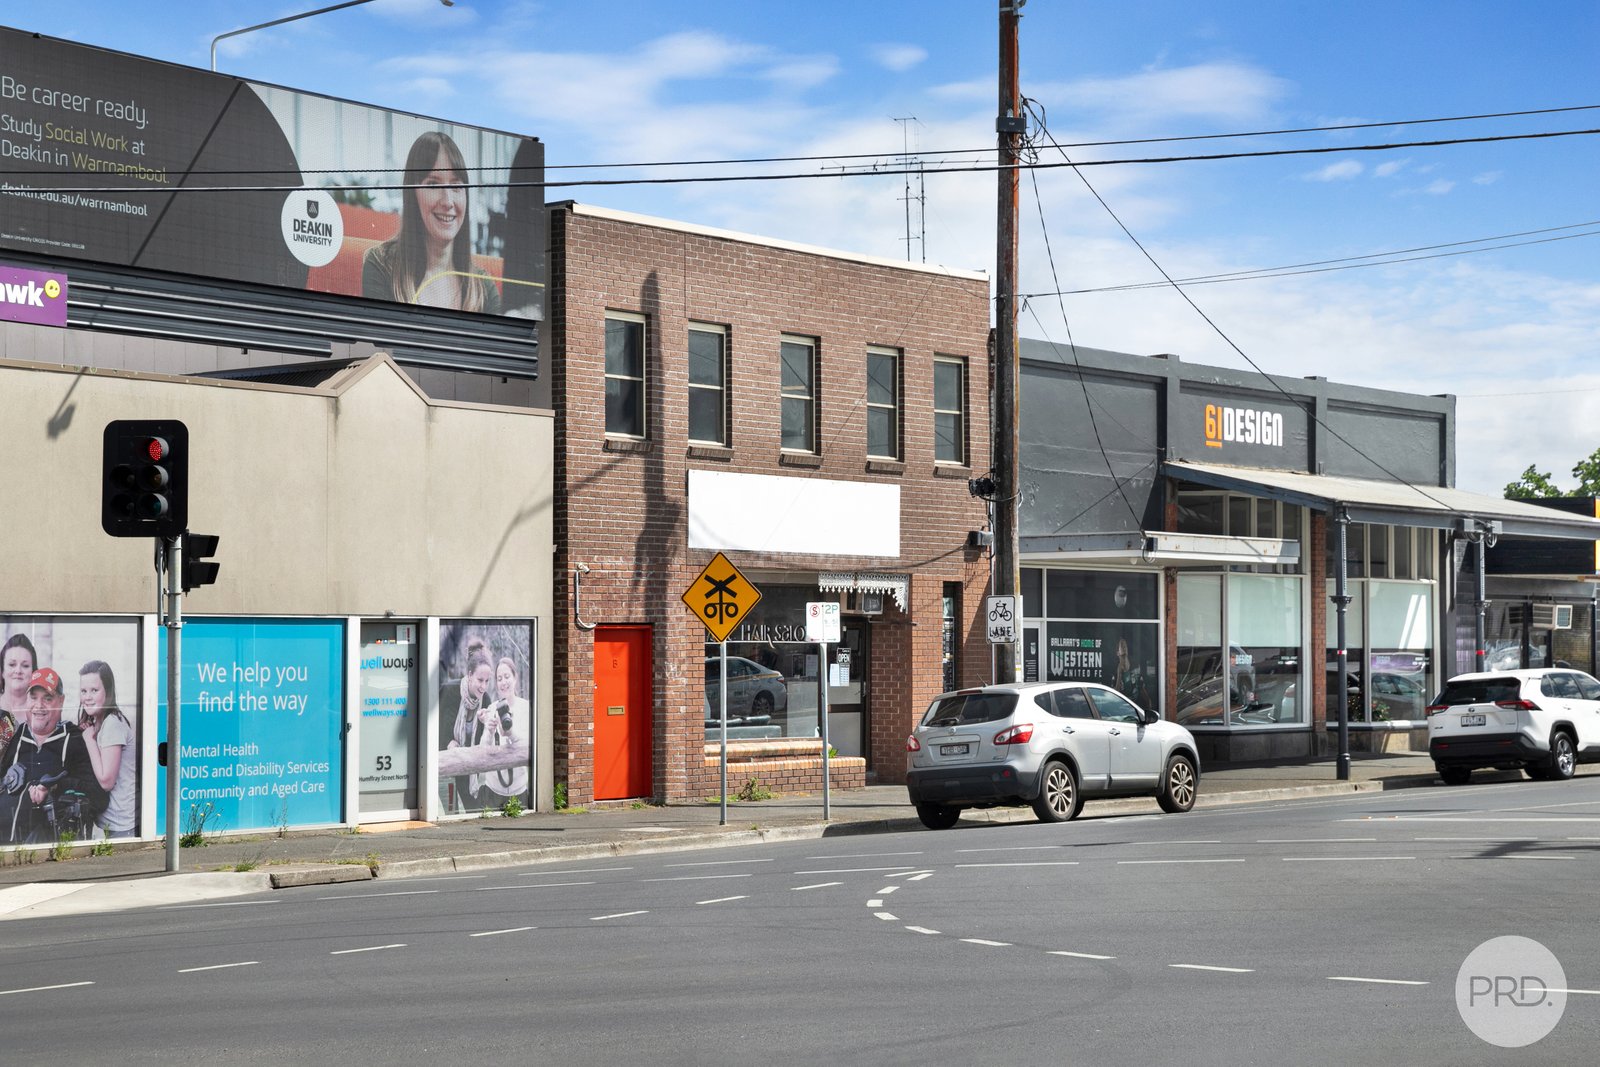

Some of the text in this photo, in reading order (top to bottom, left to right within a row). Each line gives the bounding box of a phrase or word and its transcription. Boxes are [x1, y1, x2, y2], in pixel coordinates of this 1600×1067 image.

[2, 75, 149, 129] Be career ready.
[1, 114, 145, 155] Study Social Work at
[2, 139, 170, 183] Deakin in Warrnambool.
[293, 218, 332, 237] DEAKIN
[293, 233, 333, 247] UNIVERSITY
[825, 604, 839, 614] 2P
[741, 624, 775, 649] HAIR
[989, 626, 1012, 638] LANE
[360, 656, 413, 671] wellways
[1051, 650, 1102, 676] WESTERN
[197, 661, 308, 688] We help you
[1064, 669, 1090, 677] UNITED
[198, 691, 308, 716] find the way
[181, 742, 259, 758] Mental Health
[181, 760, 330, 779] NDIS and Disability Services
[376, 755, 392, 771] 53
[180, 781, 325, 800] Community and Aged Care
